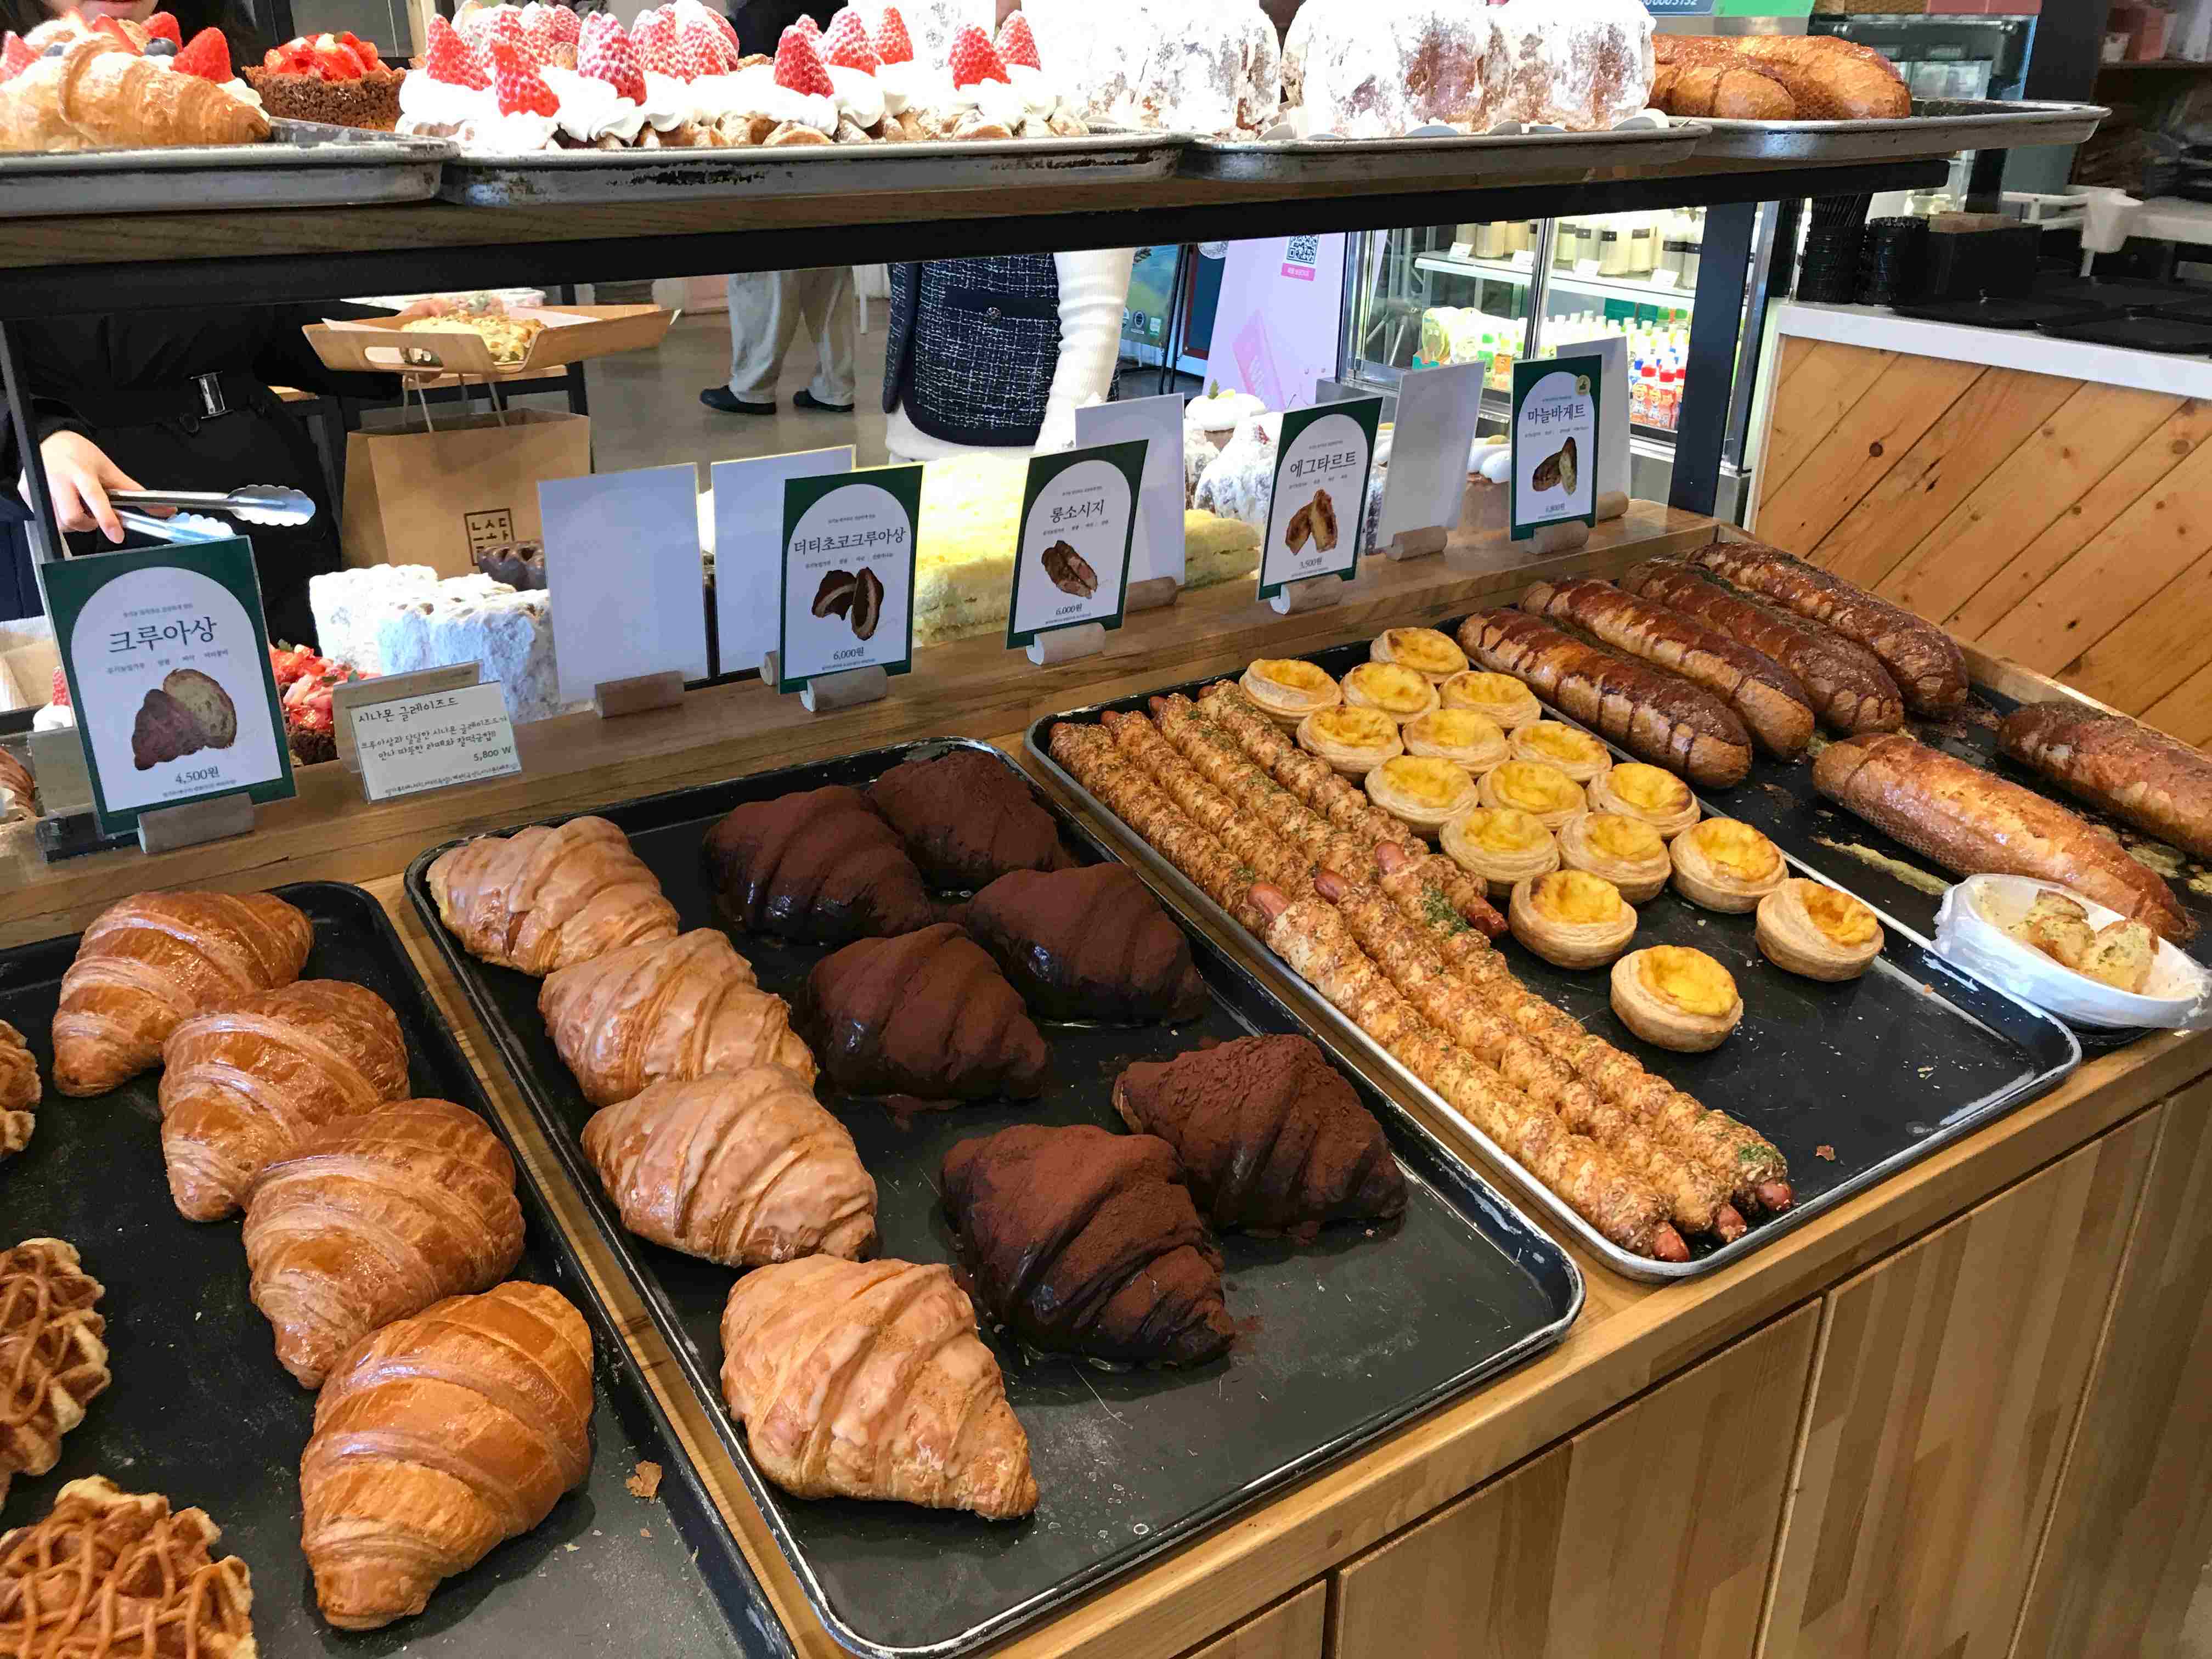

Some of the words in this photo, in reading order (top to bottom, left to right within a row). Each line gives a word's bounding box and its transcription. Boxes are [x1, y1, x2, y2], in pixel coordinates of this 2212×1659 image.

[1528, 404, 1586, 425] 마늘바게트
[1290, 451, 1357, 478] 에그타르트
[1050, 499, 1104, 523] 롱소시지
[794, 526, 907, 555] 더티초코크루아상
[109, 616, 218, 653] 크루아상
[833, 646, 865, 660] 6,000원
[359, 709, 396, 723] 시나몬
[399, 697, 459, 722] 글레이즈드
[433, 726, 457, 735] 시나몬
[378, 749, 395, 761] 만나
[473, 749, 499, 762] 5,800
[501, 746, 512, 755] W
[175, 766, 221, 785] 4,500원
